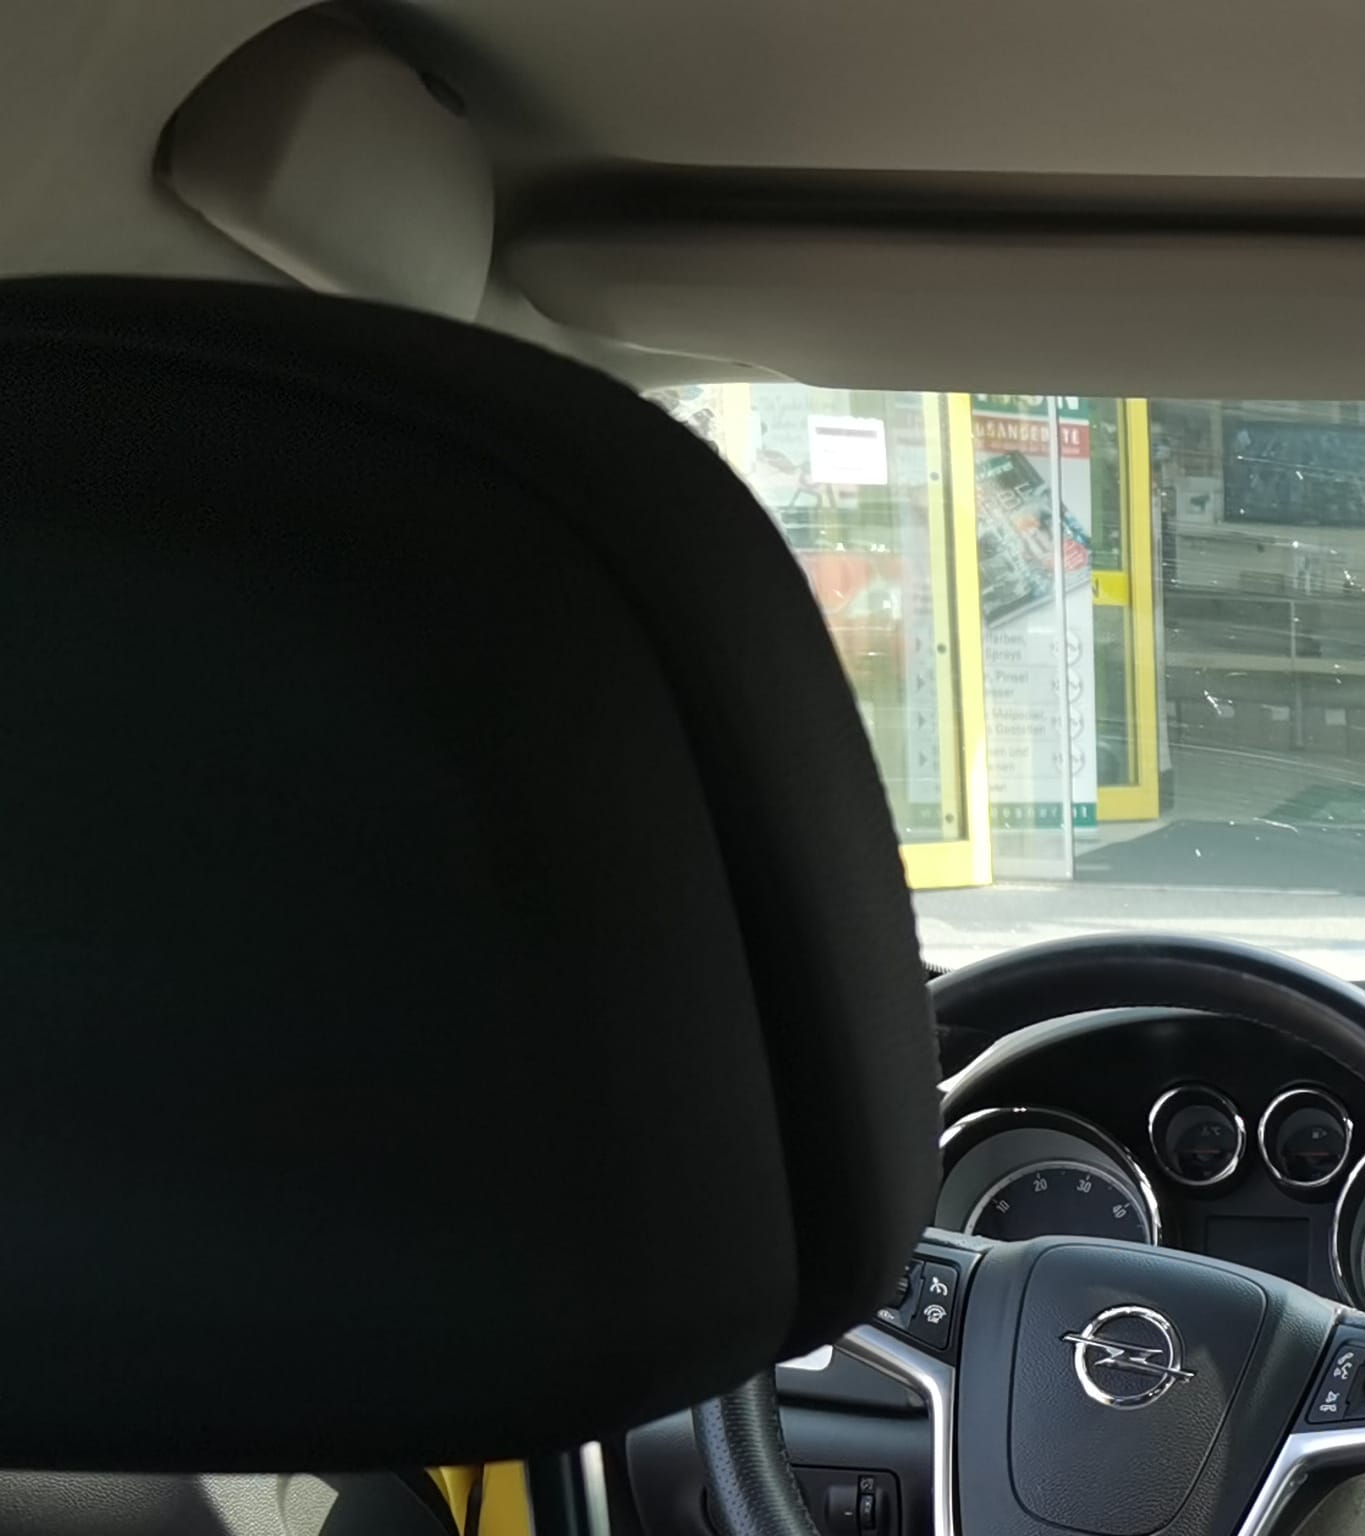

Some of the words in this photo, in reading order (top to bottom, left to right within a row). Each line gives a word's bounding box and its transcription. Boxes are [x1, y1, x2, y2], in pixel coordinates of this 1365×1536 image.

[1033, 1178, 1048, 1192] 20
[1077, 1180, 1092, 1193] 30
[1112, 1204, 1127, 1219] 40
